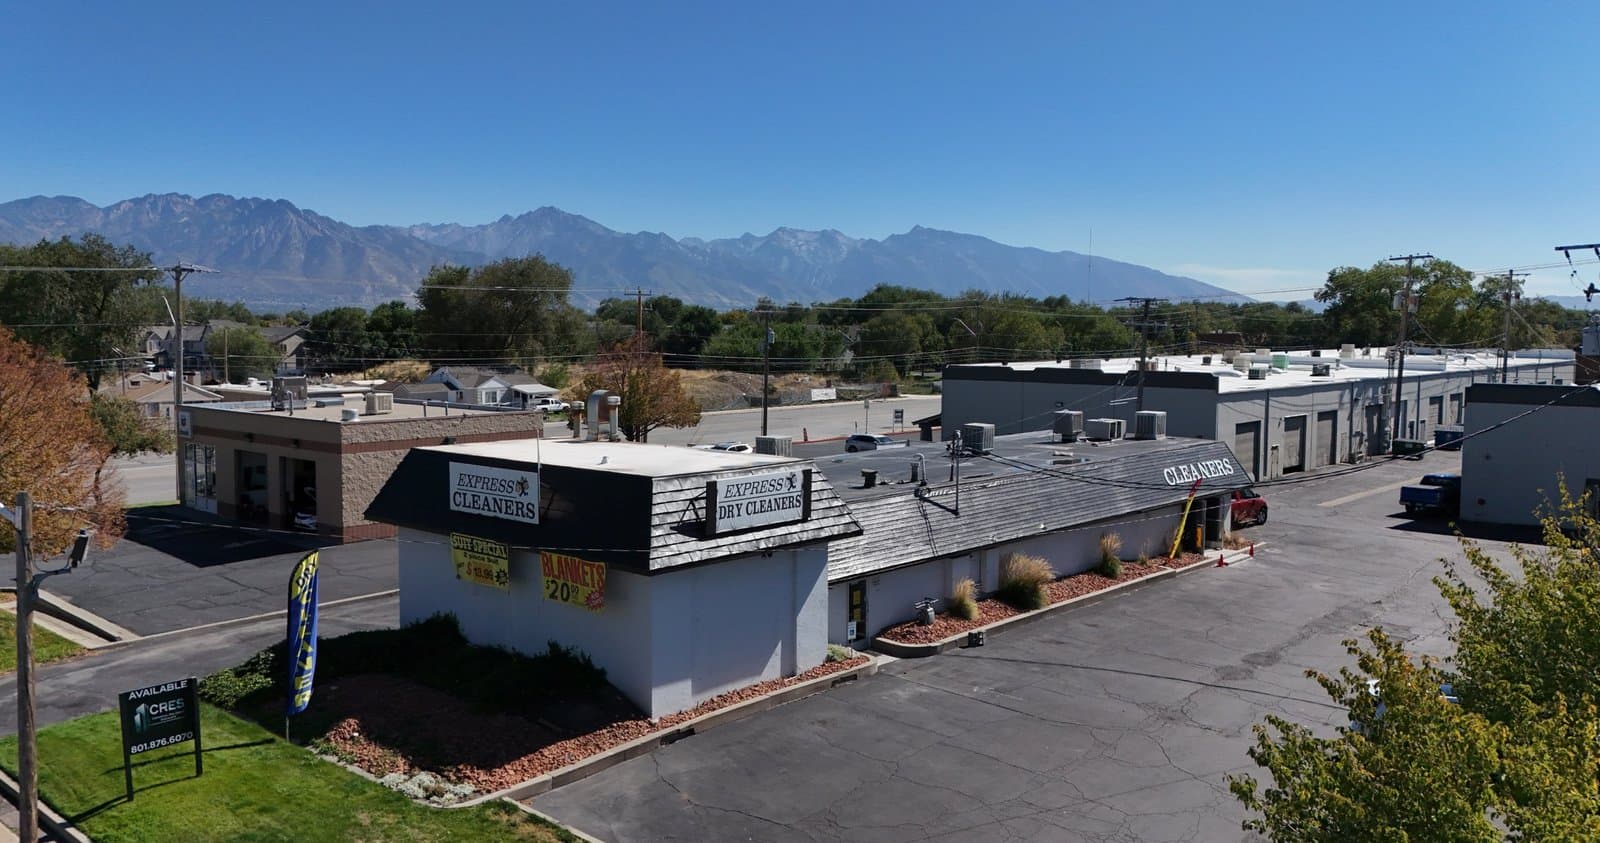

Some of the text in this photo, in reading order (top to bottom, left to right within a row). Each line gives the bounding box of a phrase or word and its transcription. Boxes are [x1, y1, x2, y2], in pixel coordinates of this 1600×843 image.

[457, 473, 515, 494] EXPRESS
[1163, 458, 1234, 486] CLEANERS
[724, 478, 784, 498] EXPRESS
[453, 491, 536, 520] CLEANERS
[718, 494, 802, 520] DRY CLEANERS
[451, 533, 508, 558] SUIT SPECIAL
[541, 552, 606, 592] BLANKETS
[128, 680, 188, 700] AVAILABLE
[149, 698, 185, 715] CRES
[130, 731, 193, 754] 801.876.6070
